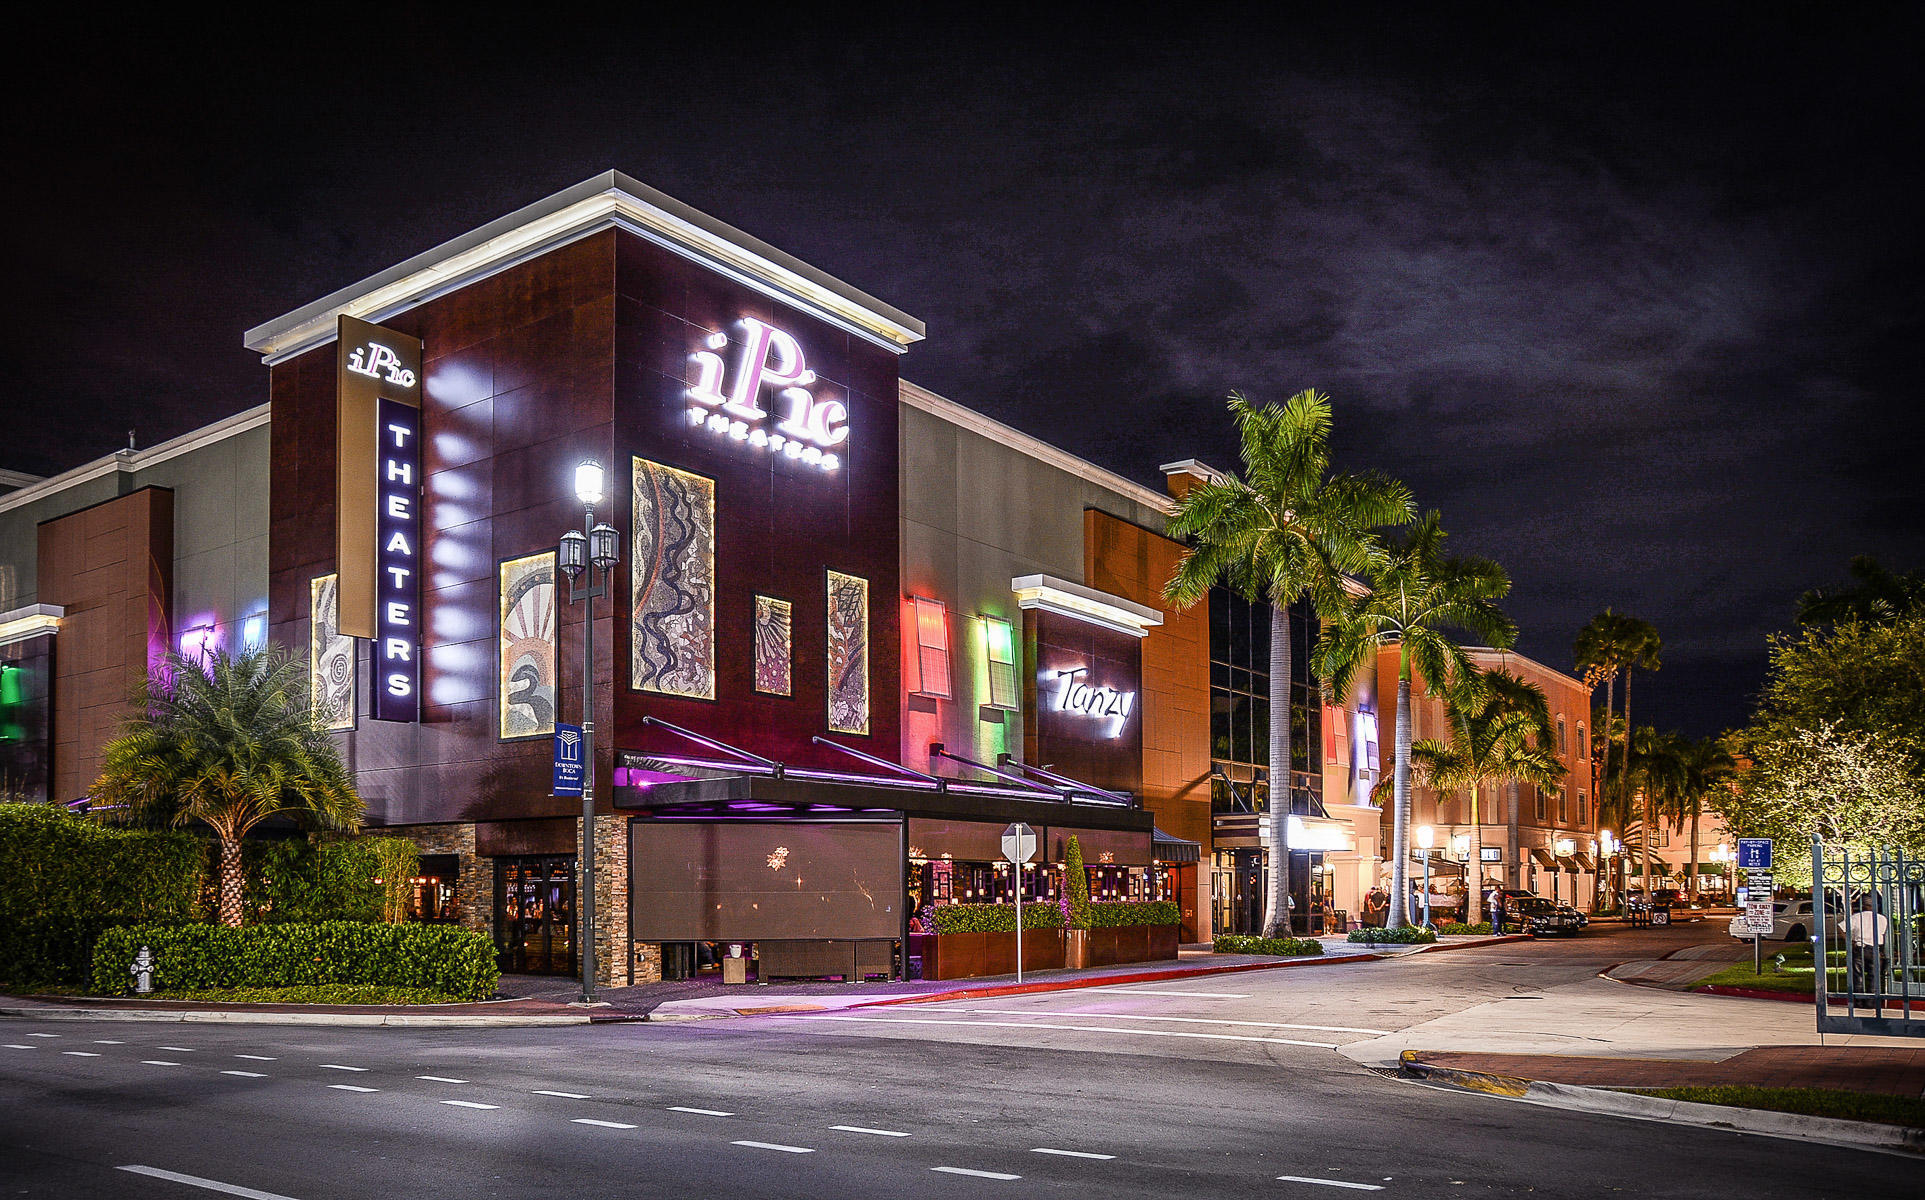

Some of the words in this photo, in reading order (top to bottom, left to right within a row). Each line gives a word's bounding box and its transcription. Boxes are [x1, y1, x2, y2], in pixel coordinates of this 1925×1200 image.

[347, 342, 416, 388] iPic
[681, 316, 849, 447] iPic
[686, 406, 840, 471] THEATERS
[386, 423, 412, 697] THEATERS
[1057, 667, 1137, 738] Tanzy
